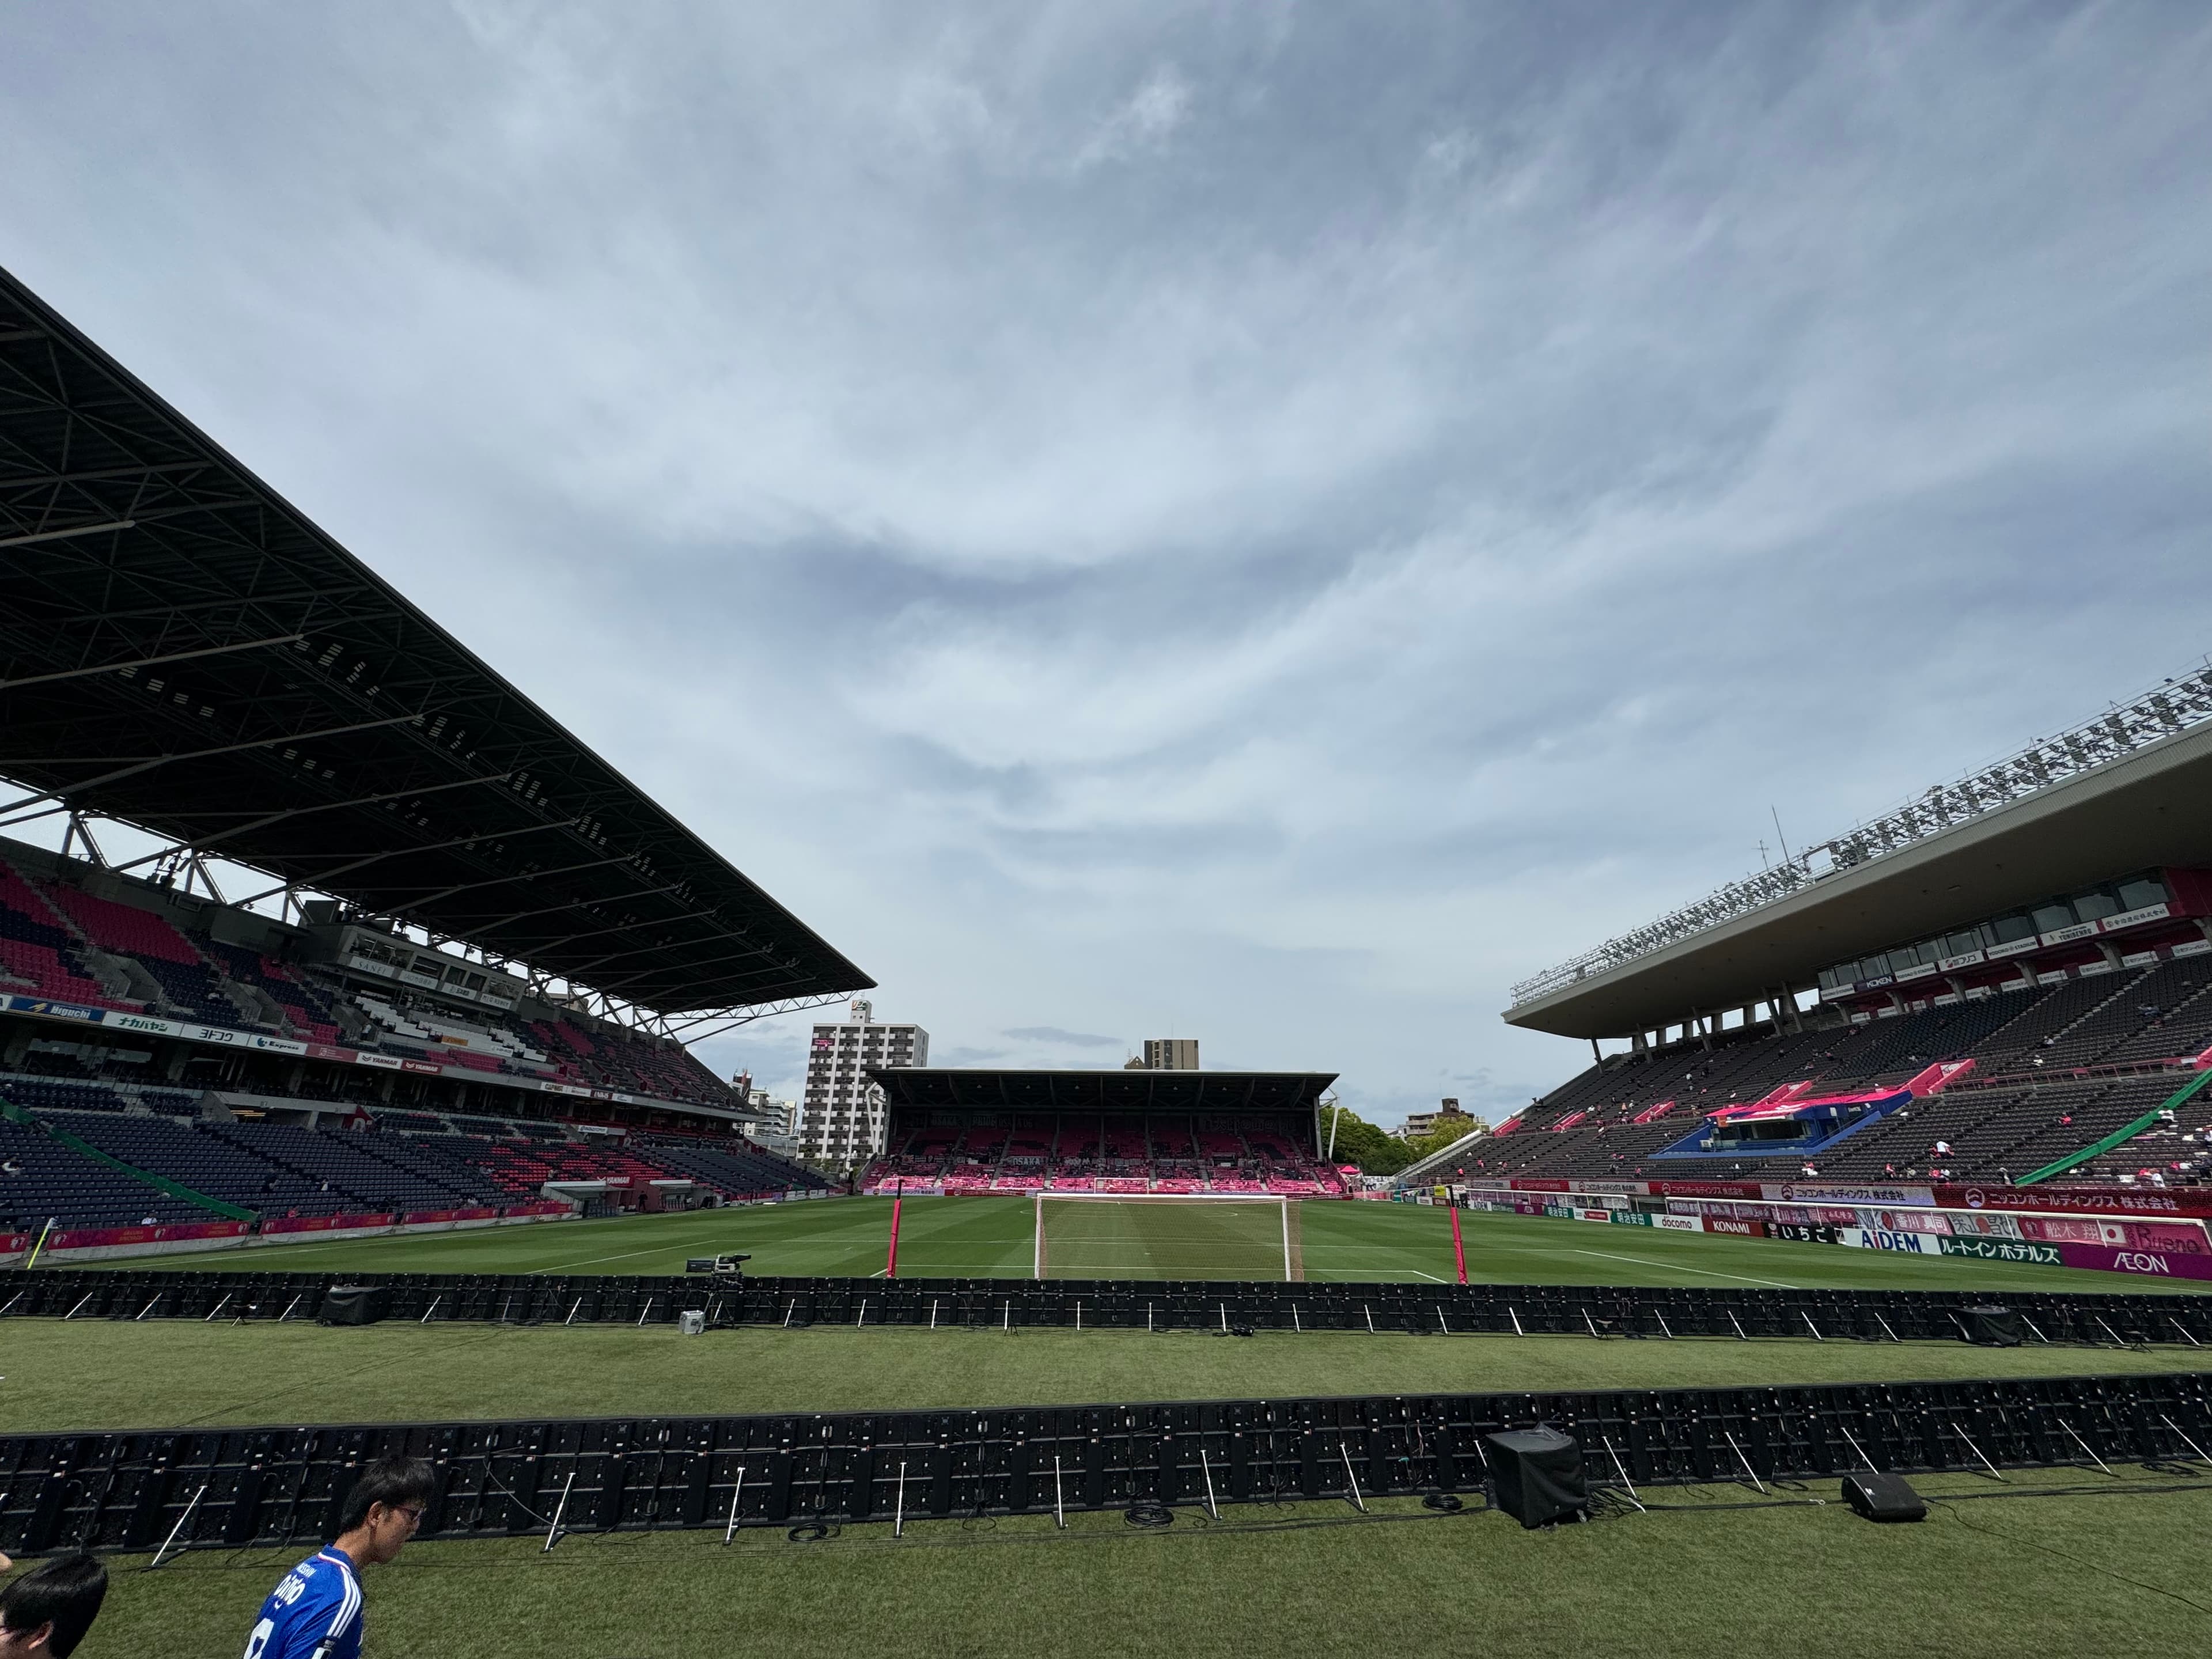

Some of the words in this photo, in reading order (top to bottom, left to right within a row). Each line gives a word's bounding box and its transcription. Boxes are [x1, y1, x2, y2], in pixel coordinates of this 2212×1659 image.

[1866, 976, 1893, 988] KOKEN
[50, 1005, 90, 1019] Higuchi
[118, 1017, 169, 1032] ナカバヤシ
[268, 1040, 300, 1051] Express
[372, 1056, 398, 1066] YANMAR
[1013, 1157, 1041, 1165] OSAKA
[607, 1176, 631, 1184] YANMAR
[1795, 1188, 1872, 1199] ニッコンホールディングス
[1873, 1188, 1906, 1201] 株式会社
[1989, 1193, 2119, 1208] ニッコンホールディングス
[2120, 1195, 2180, 1210] 株式会社
[1616, 1211, 1645, 1225] 明治安田
[1662, 1216, 1692, 1229] docomo
[1895, 1212, 1920, 1229] 香川
[1921, 1214, 1948, 1232] 真司
[1713, 1221, 1750, 1234] KONAMI
[1782, 1226, 1828, 1243] いちご
[1862, 1229, 1922, 1253] AiDEM
